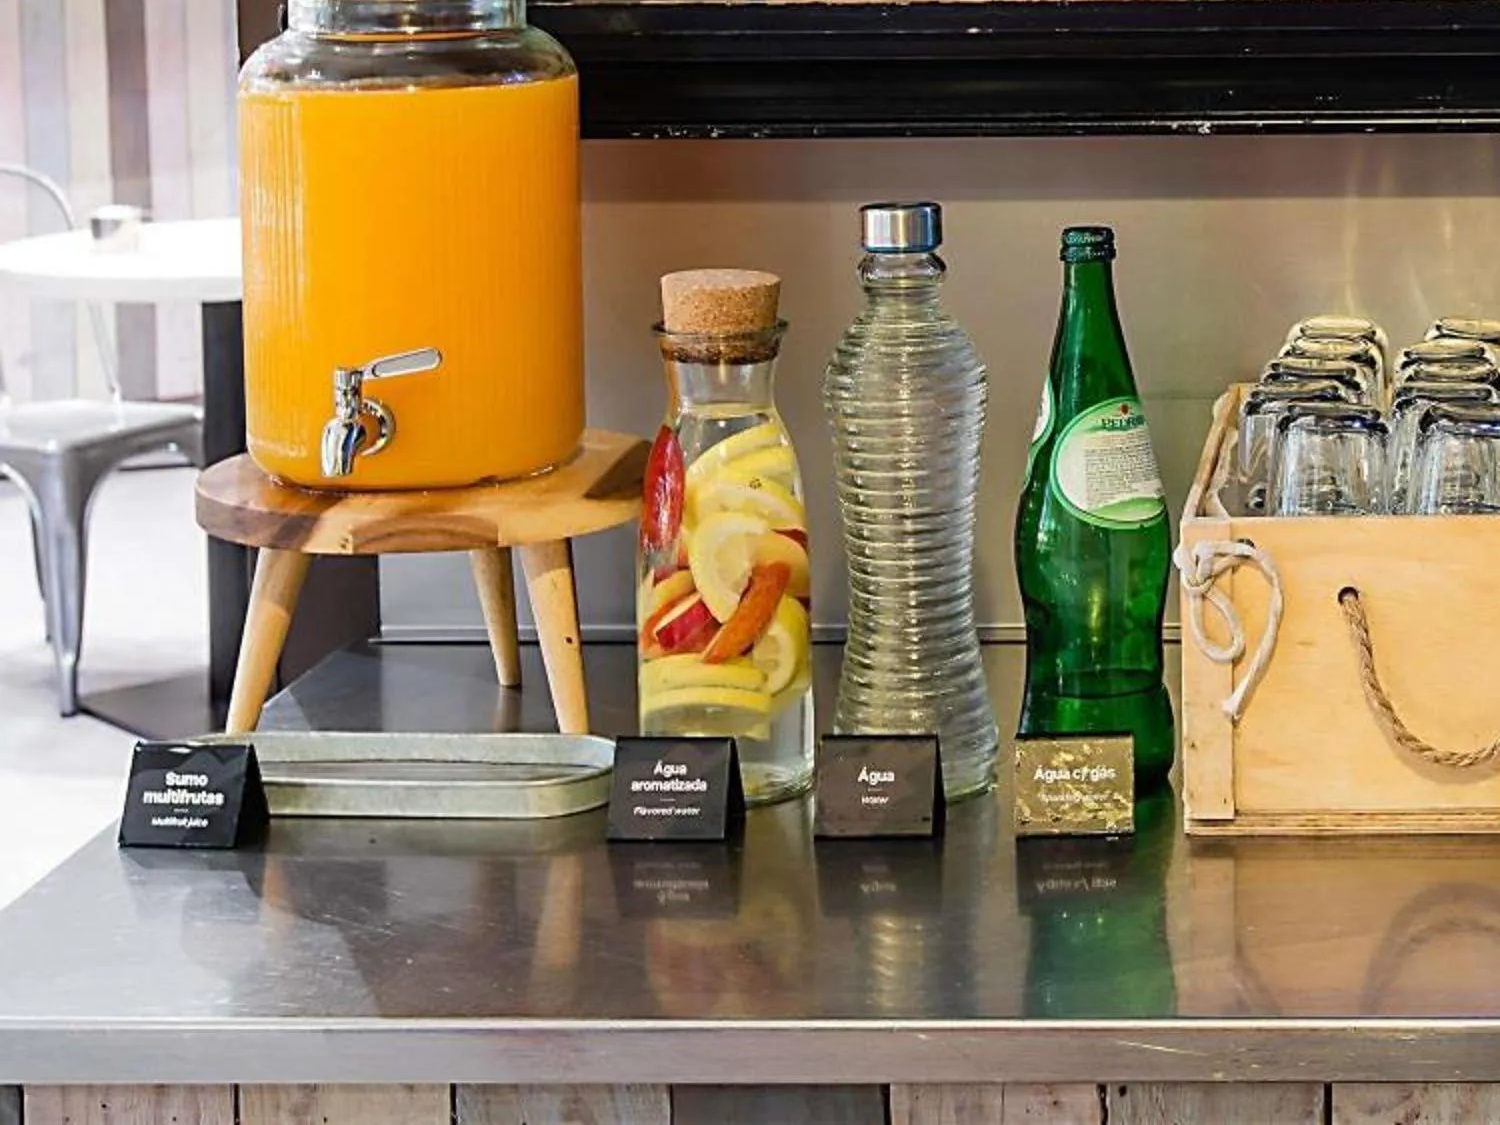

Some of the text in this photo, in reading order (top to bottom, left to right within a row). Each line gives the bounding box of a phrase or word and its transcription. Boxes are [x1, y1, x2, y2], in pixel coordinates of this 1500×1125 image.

[653, 759, 688, 778] Água
[857, 765, 895, 785] Água
[1033, 764, 1071, 783] Água
[165, 771, 209, 787] Sumo
[631, 778, 708, 792] aromatizada
[143, 788, 225, 806] multifrutas
